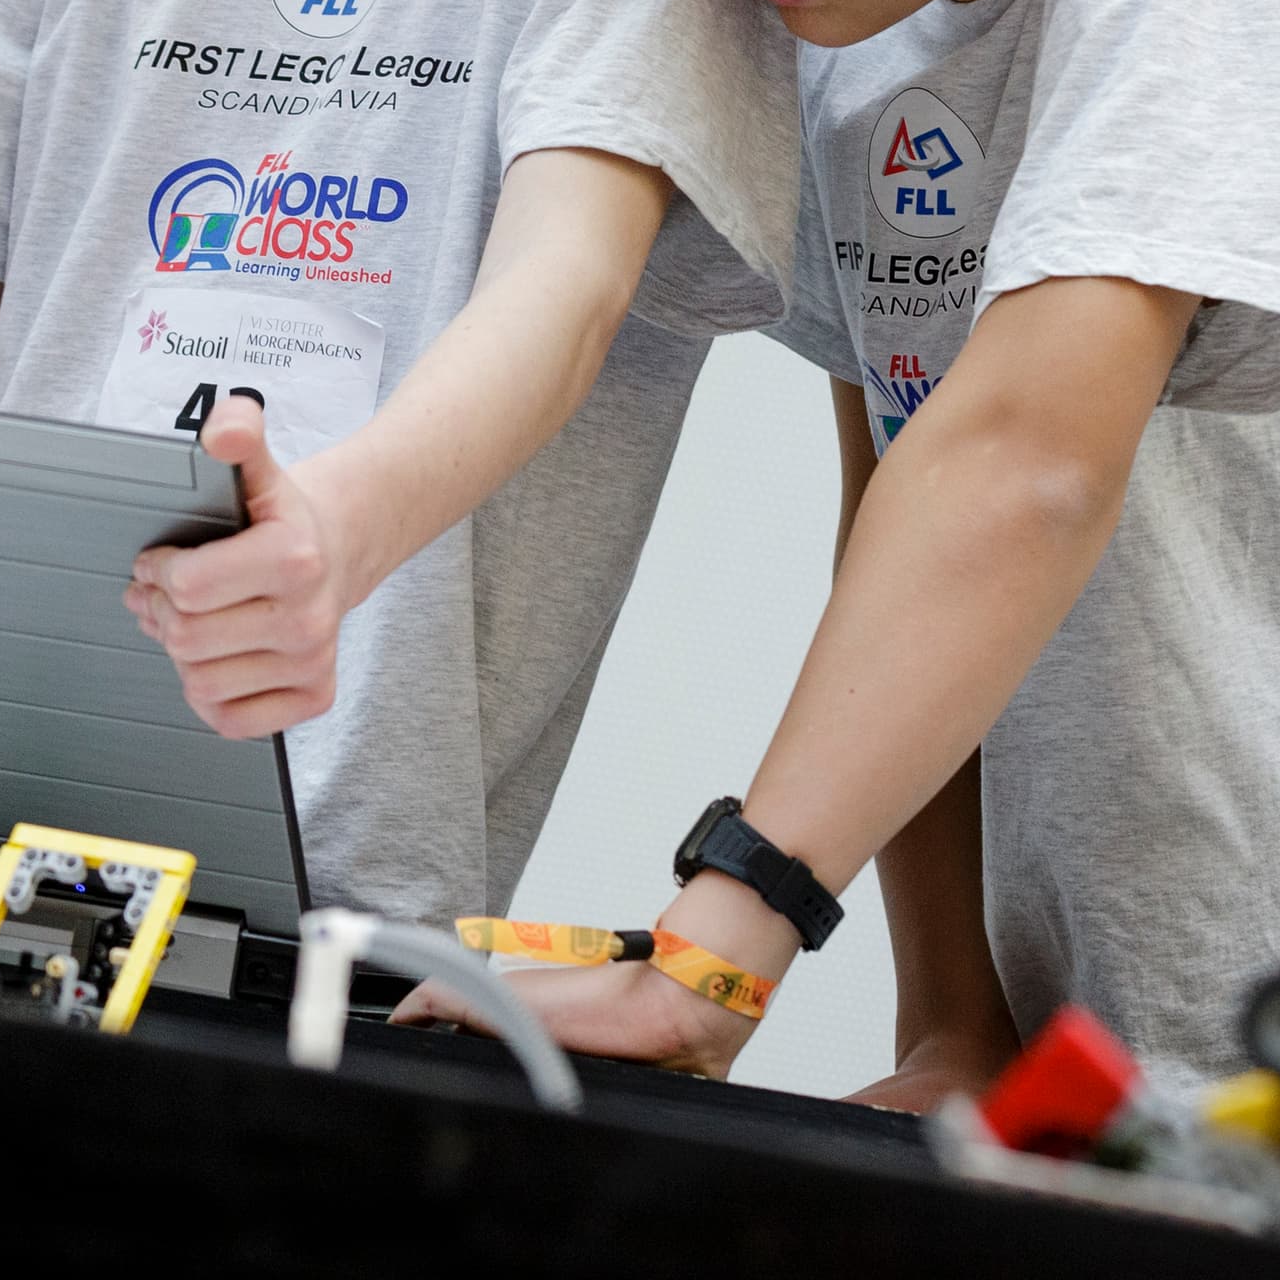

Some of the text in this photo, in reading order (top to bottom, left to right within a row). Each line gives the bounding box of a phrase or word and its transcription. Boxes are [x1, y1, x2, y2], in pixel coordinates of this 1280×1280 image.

[134, 38, 244, 77] FIRST
[198, 88, 398, 116] SCANDIAVIA
[256, 150, 293, 176] FLL
[245, 171, 409, 223] WORLD
[895, 187, 956, 216] FLL
[835, 241, 865, 271] FIR
[235, 260, 393, 285] Learning Unleashed
[162, 331, 229, 360] Statoil
[243, 350, 293, 369] HELTER
[246, 333, 363, 361] MORGENDAGENS
[889, 354, 927, 379] FLL
[174, 382, 266, 442] 4
